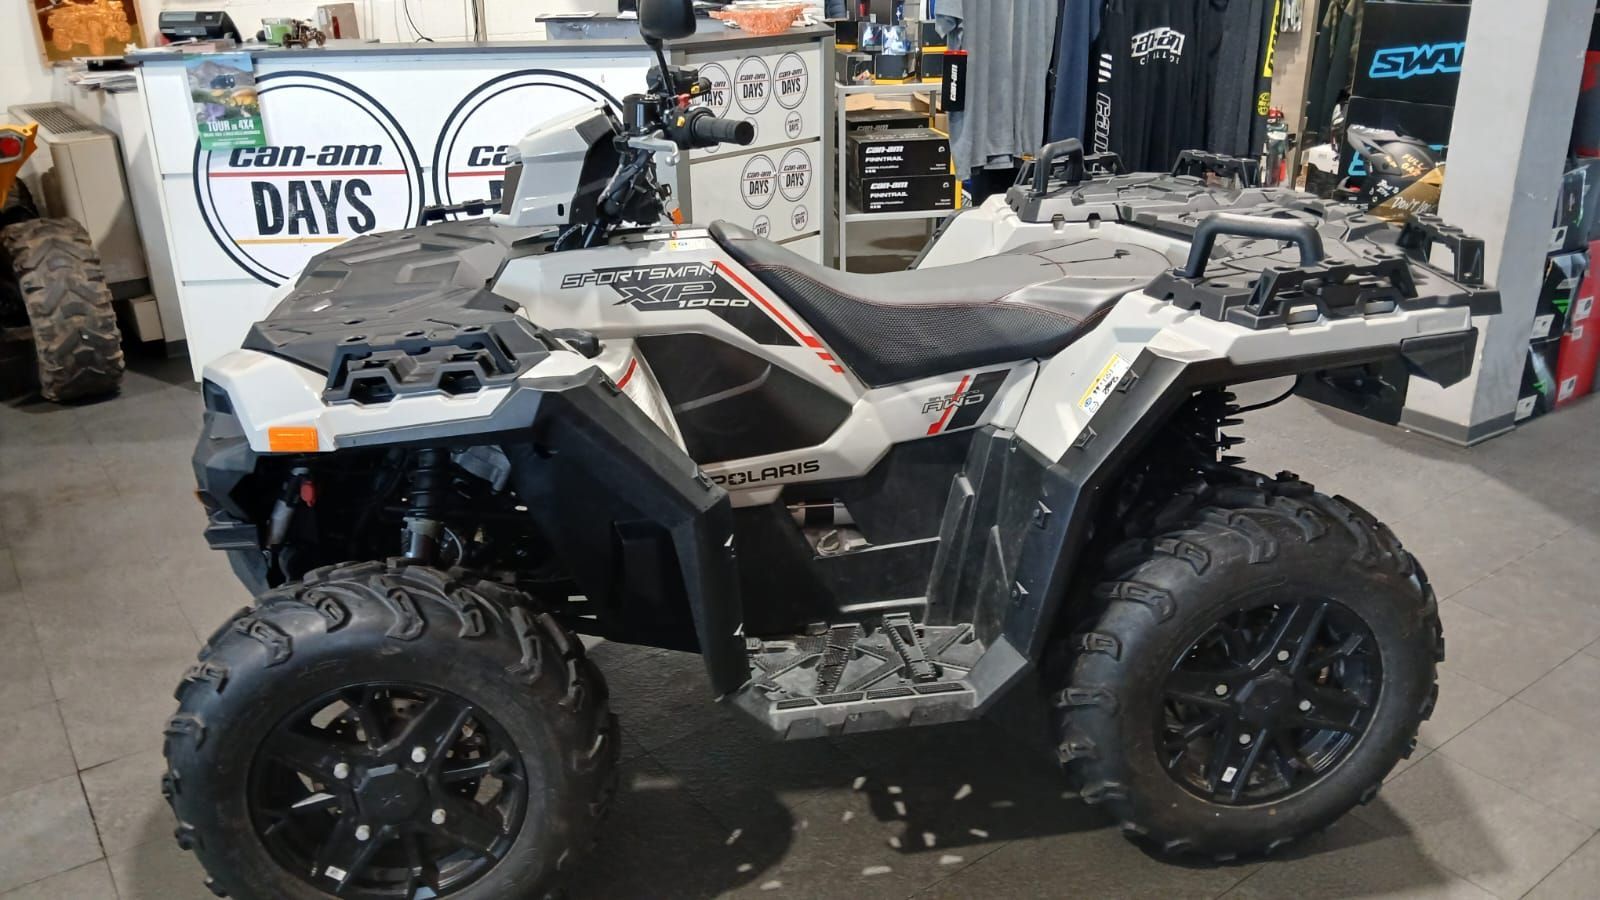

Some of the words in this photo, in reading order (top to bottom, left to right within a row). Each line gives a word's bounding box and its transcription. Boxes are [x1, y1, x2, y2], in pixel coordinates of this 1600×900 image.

[1369, 42, 1464, 79] SWA
[743, 83, 763, 98] DAYS
[781, 78, 801, 95] DAYS
[207, 120, 230, 132] TOUR
[238, 119, 254, 130] 4X4
[229, 144, 383, 168] can-am
[865, 146, 904, 154] can-am
[750, 180, 768, 195] DAYS
[786, 173, 804, 187] DAYS
[870, 182, 909, 190] can-am
[251, 178, 376, 235] DAYS
[560, 263, 718, 289] SPORTSMAN
[612, 280, 717, 306] XP
[678, 298, 751, 309] 1000
[922, 394, 985, 414] AWD
[710, 460, 820, 485] POLARIS
